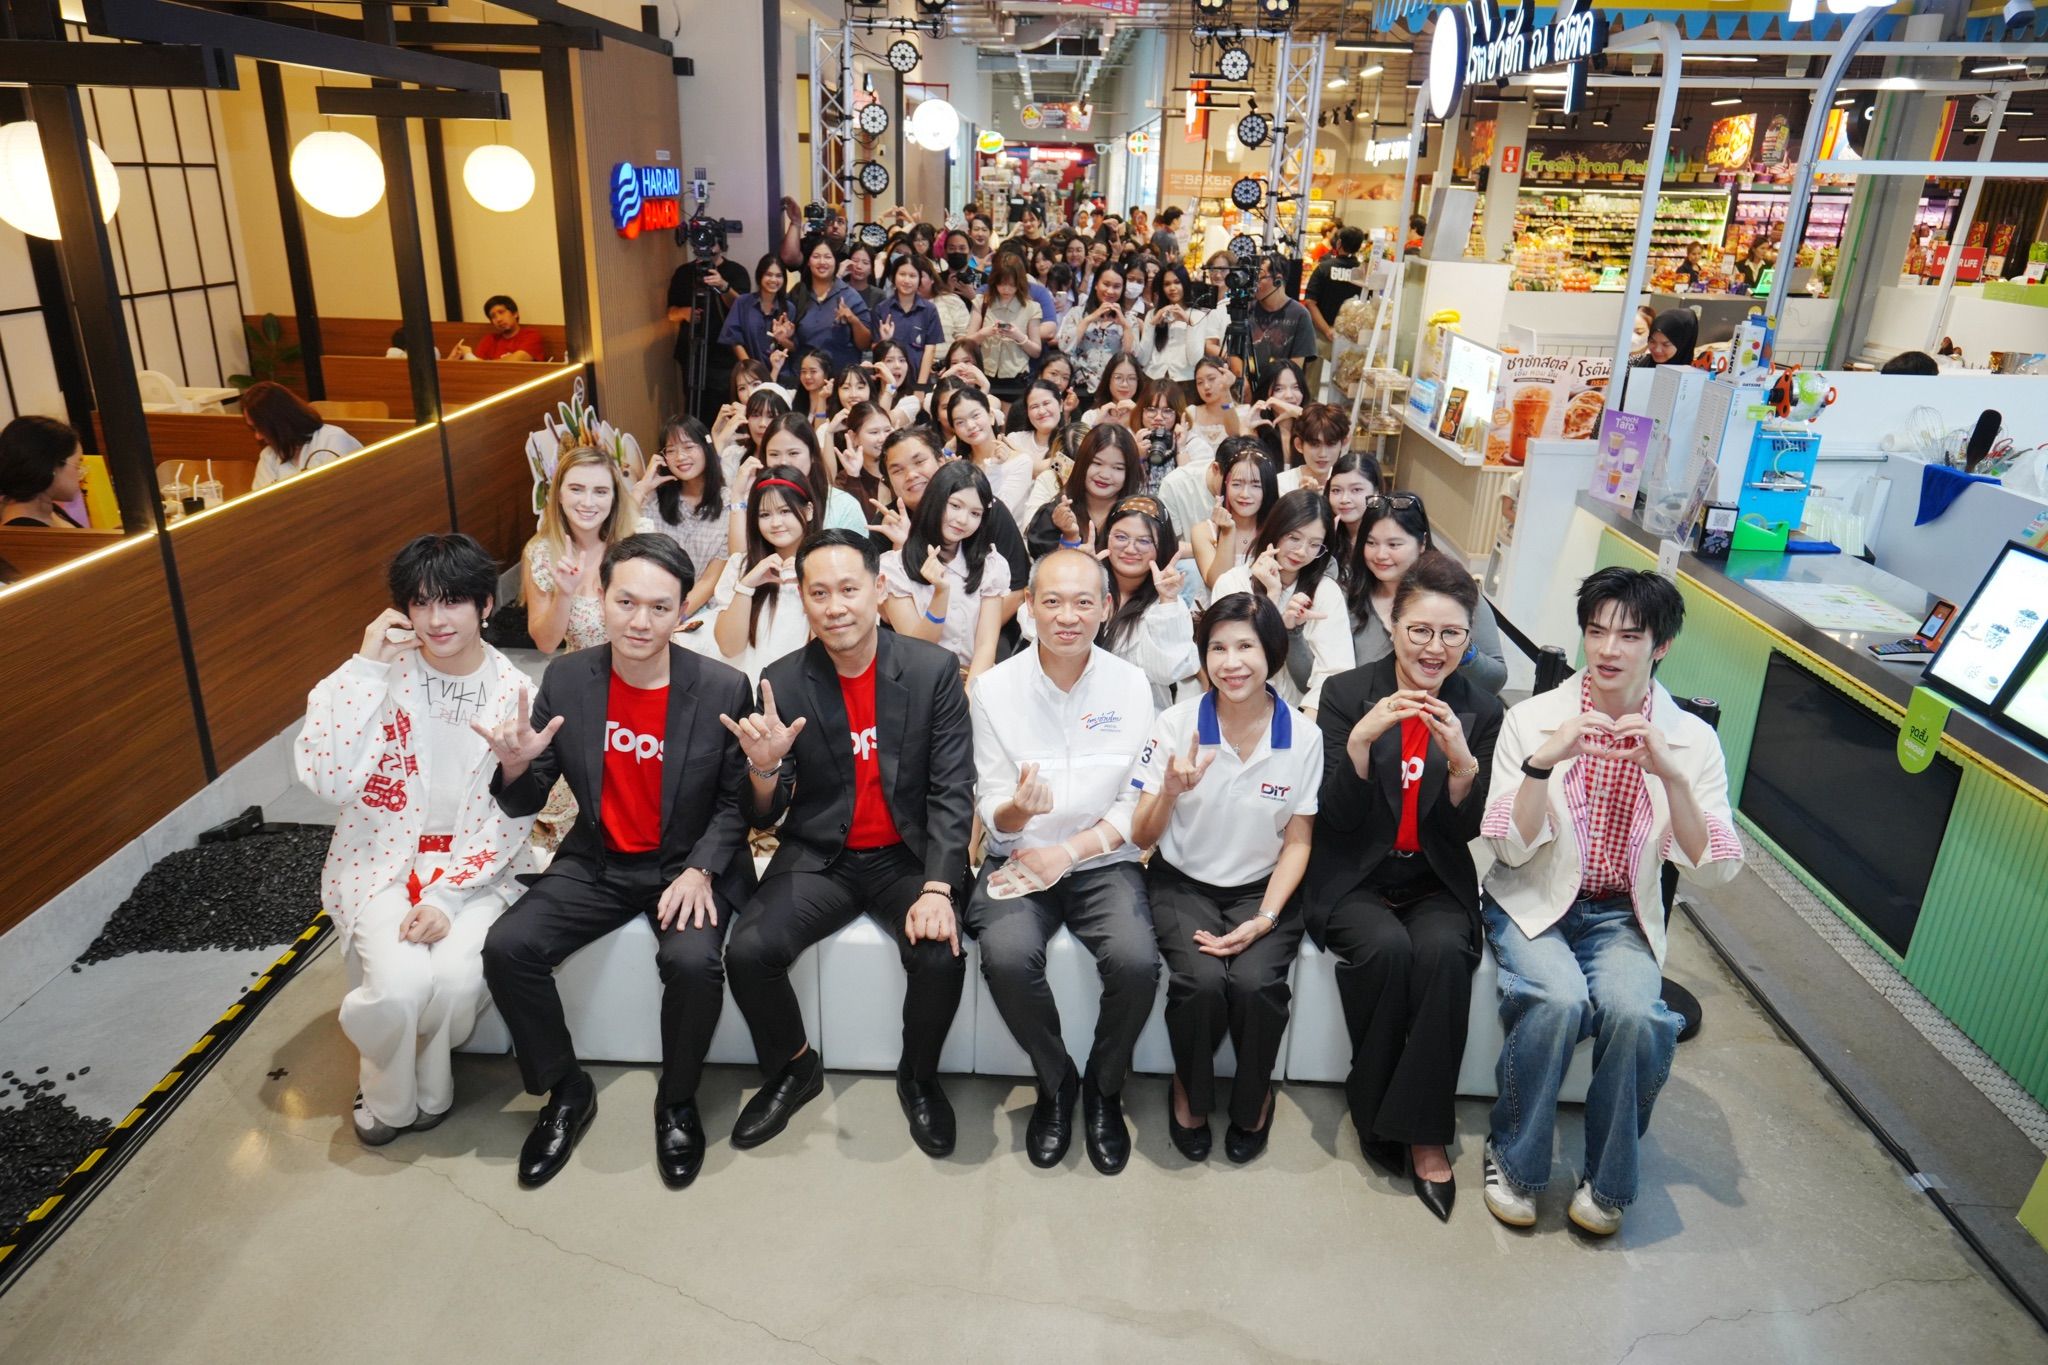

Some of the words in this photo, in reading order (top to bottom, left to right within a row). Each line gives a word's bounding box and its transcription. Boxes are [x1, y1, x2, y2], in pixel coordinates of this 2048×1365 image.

[1525, 150, 1576, 173] Fresh
[1577, 152, 1619, 174] from
[642, 168, 680, 196] HARARU
[1963, 258, 1979, 268] LIFE
[1727, 333, 1740, 374] OATSIDE
[1615, 417, 1635, 431] Taro
[1622, 415, 1639, 423] mochi
[361, 773, 408, 813] 56
